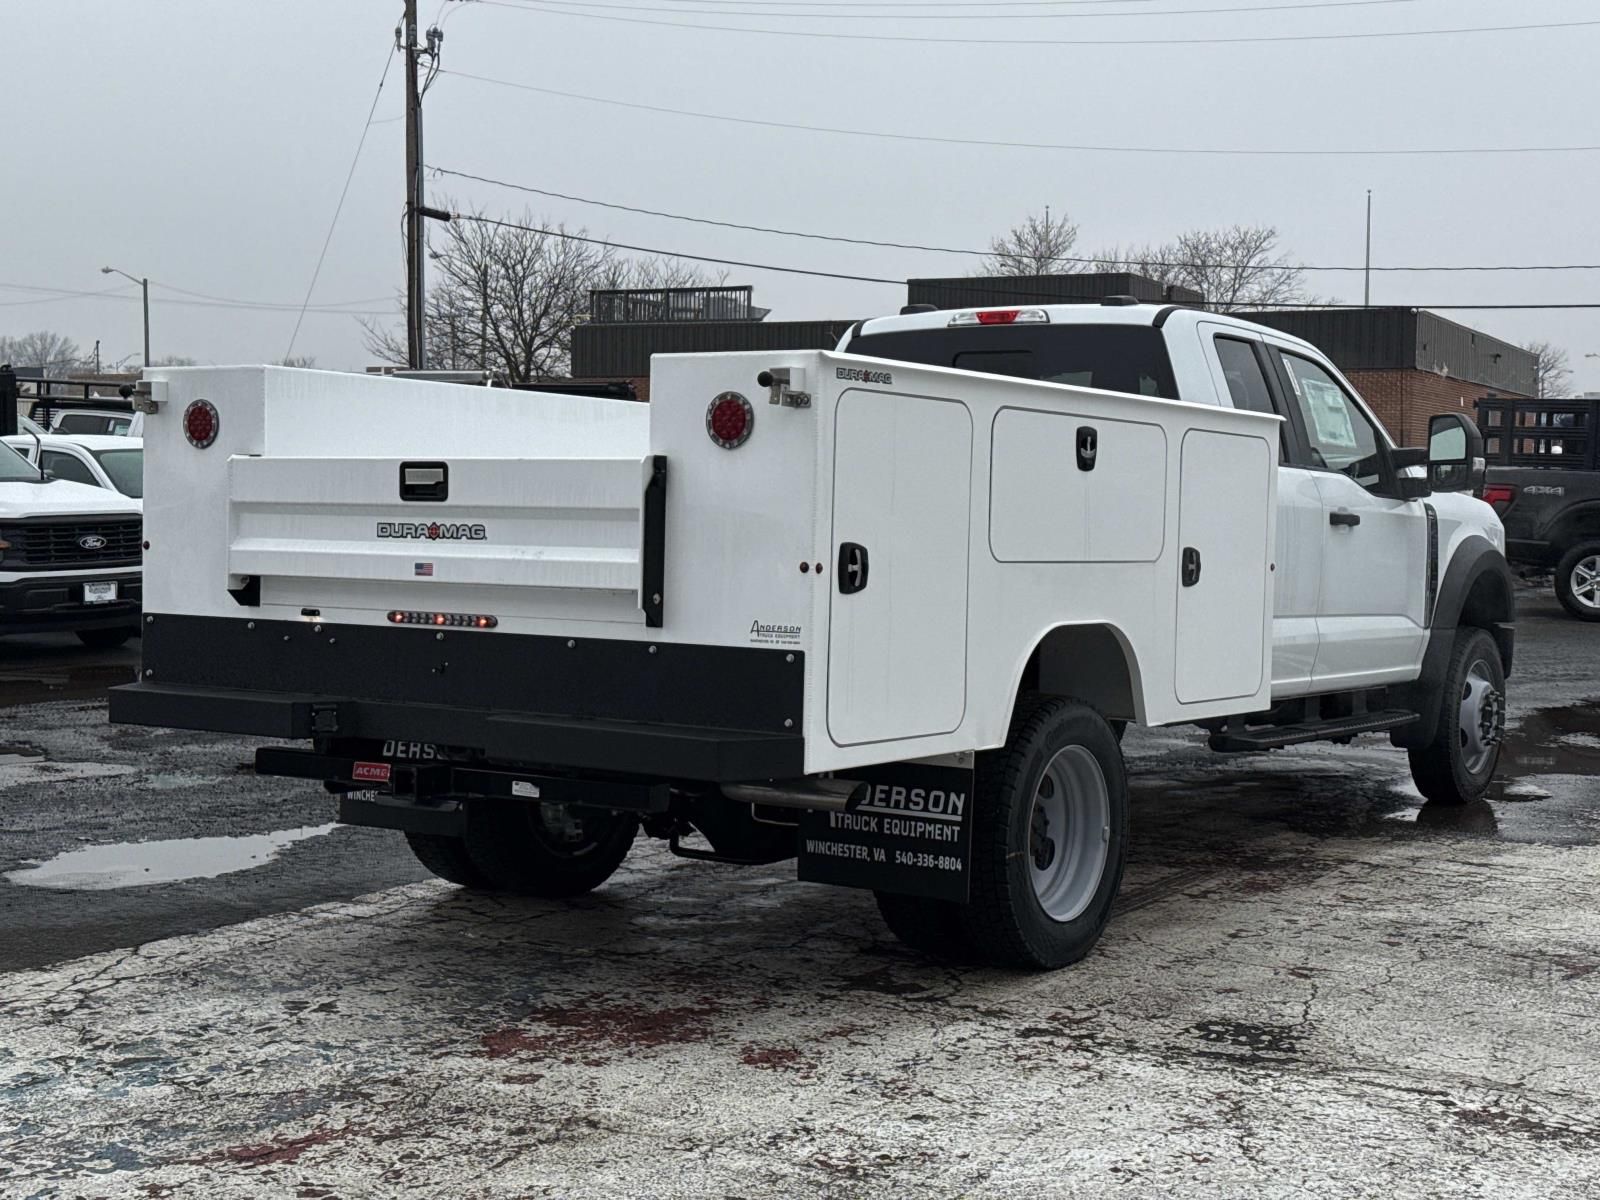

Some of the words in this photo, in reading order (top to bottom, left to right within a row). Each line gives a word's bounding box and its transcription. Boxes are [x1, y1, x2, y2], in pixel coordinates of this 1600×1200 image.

[750, 619, 801, 638] ANDERSON
[355, 767, 387, 777] ACME
[836, 812, 878, 833] TRUCK
[883, 818, 961, 842] EQUIPMENT
[806, 839, 871, 862] WINCHESTER,
[873, 848, 887, 862] VA
[895, 850, 962, 872] 540-336-8804
